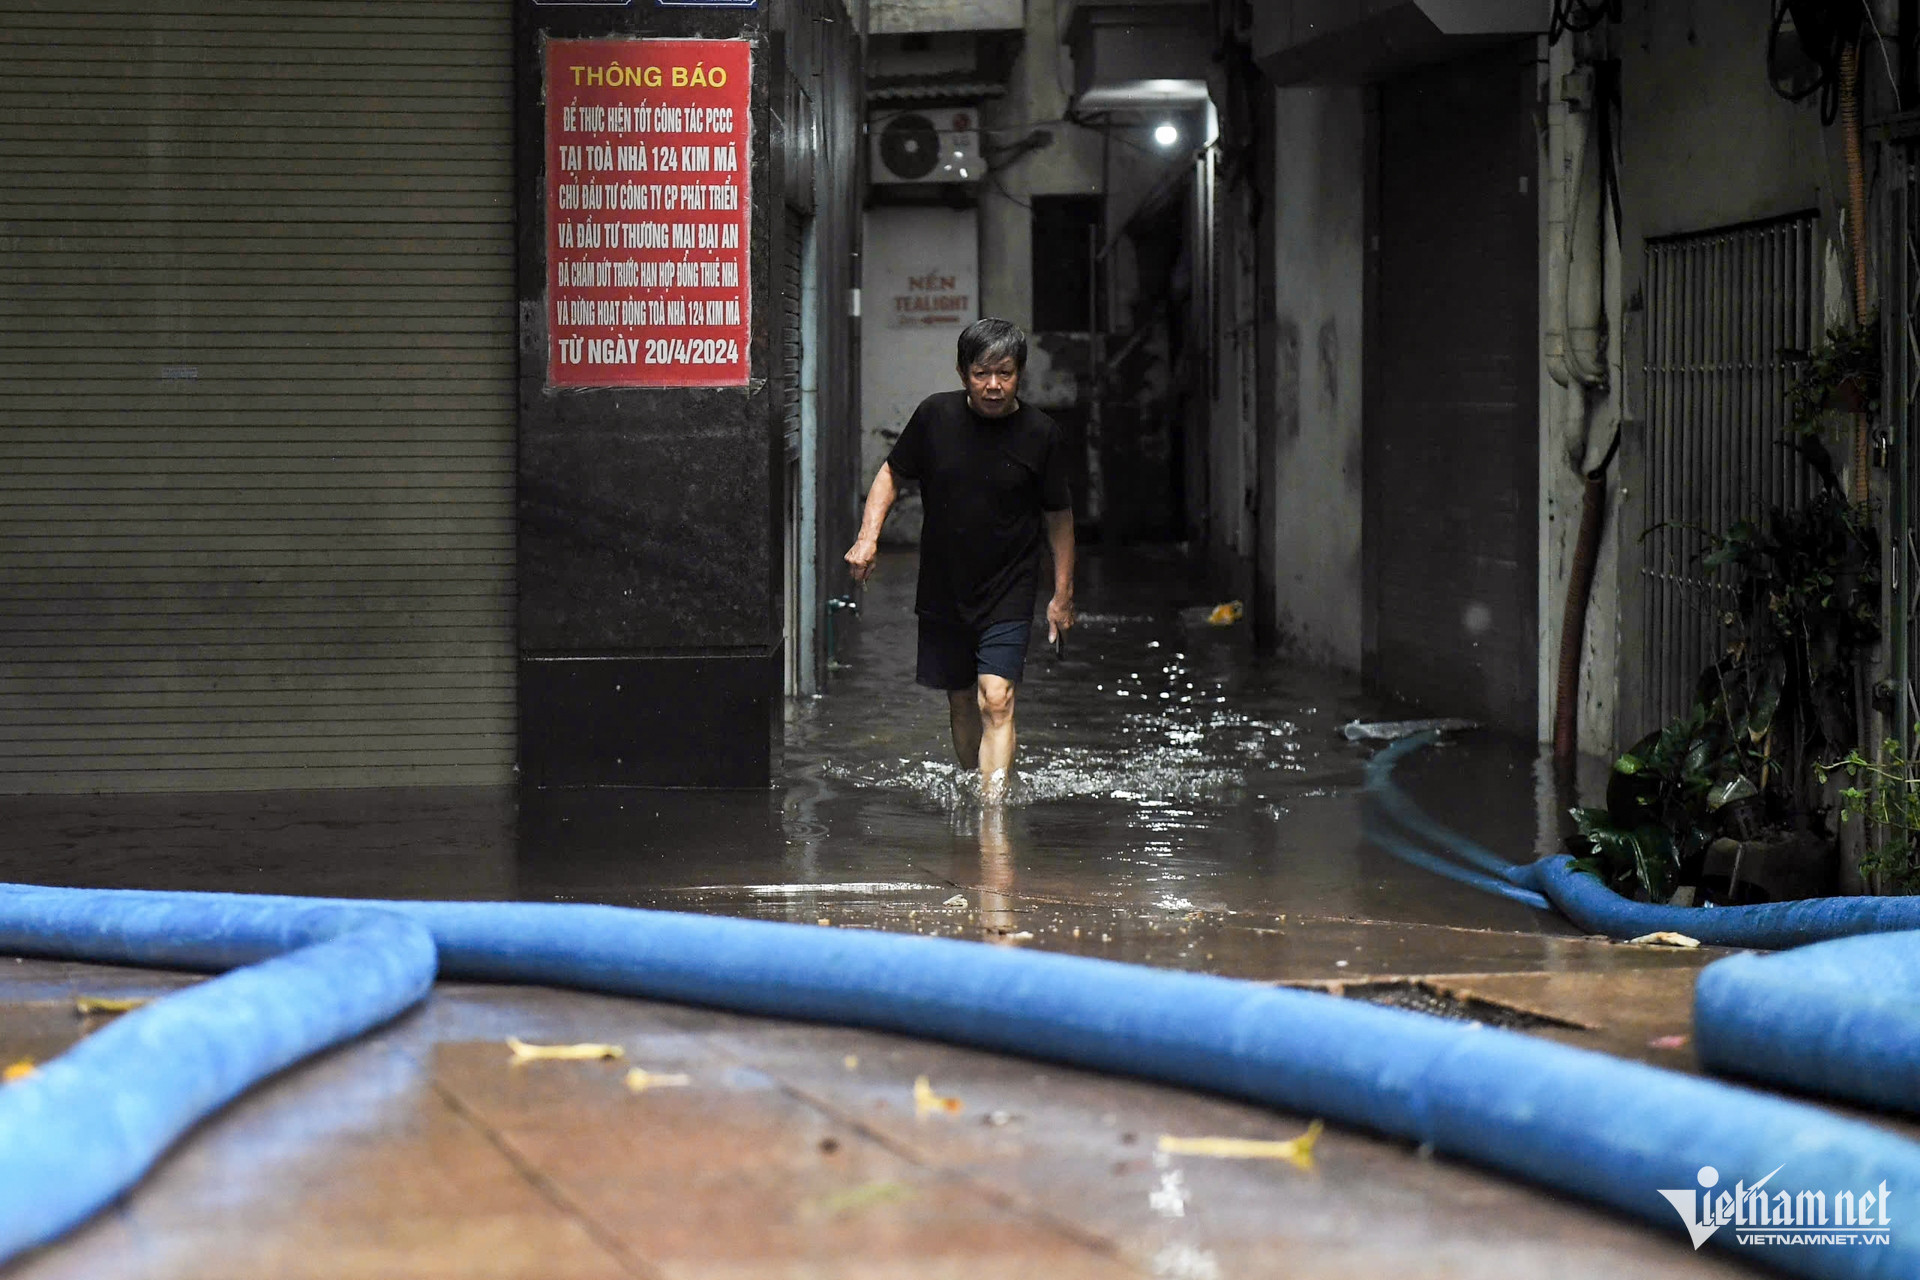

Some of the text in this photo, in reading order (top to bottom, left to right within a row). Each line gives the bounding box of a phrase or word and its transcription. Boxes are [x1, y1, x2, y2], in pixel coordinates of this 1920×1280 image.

[570, 61, 727, 87] THÔNG BÁO
[563, 97, 732, 138] ĐỂ THỰC HIỆN TỐT CÔNG TÁC PCCC
[559, 141, 737, 176] TẠI TOÀ NHÀ 124 KIM MÃ
[559, 175, 737, 210] CHỦ ĐẦU TƯ CÔNG TY CP PHÁT TRIỂN
[558, 215, 738, 254] VÀ ĐẦU TƯ THƯƠNG MẠI ĐẠI AN
[558, 253, 738, 292] ĐÃ CHẤM DỨT TRƯỚC HẠN HỢP ĐỒNG THUÊ NHÀ
[557, 295, 740, 331] VÀ DỪNG HOẠT ĐỘNG TOÀ NHÀ 124 KIM MÃ
[894, 296, 968, 311] TEALIGHT
[559, 334, 738, 364] TỪ NGÀY 20/4/2024
